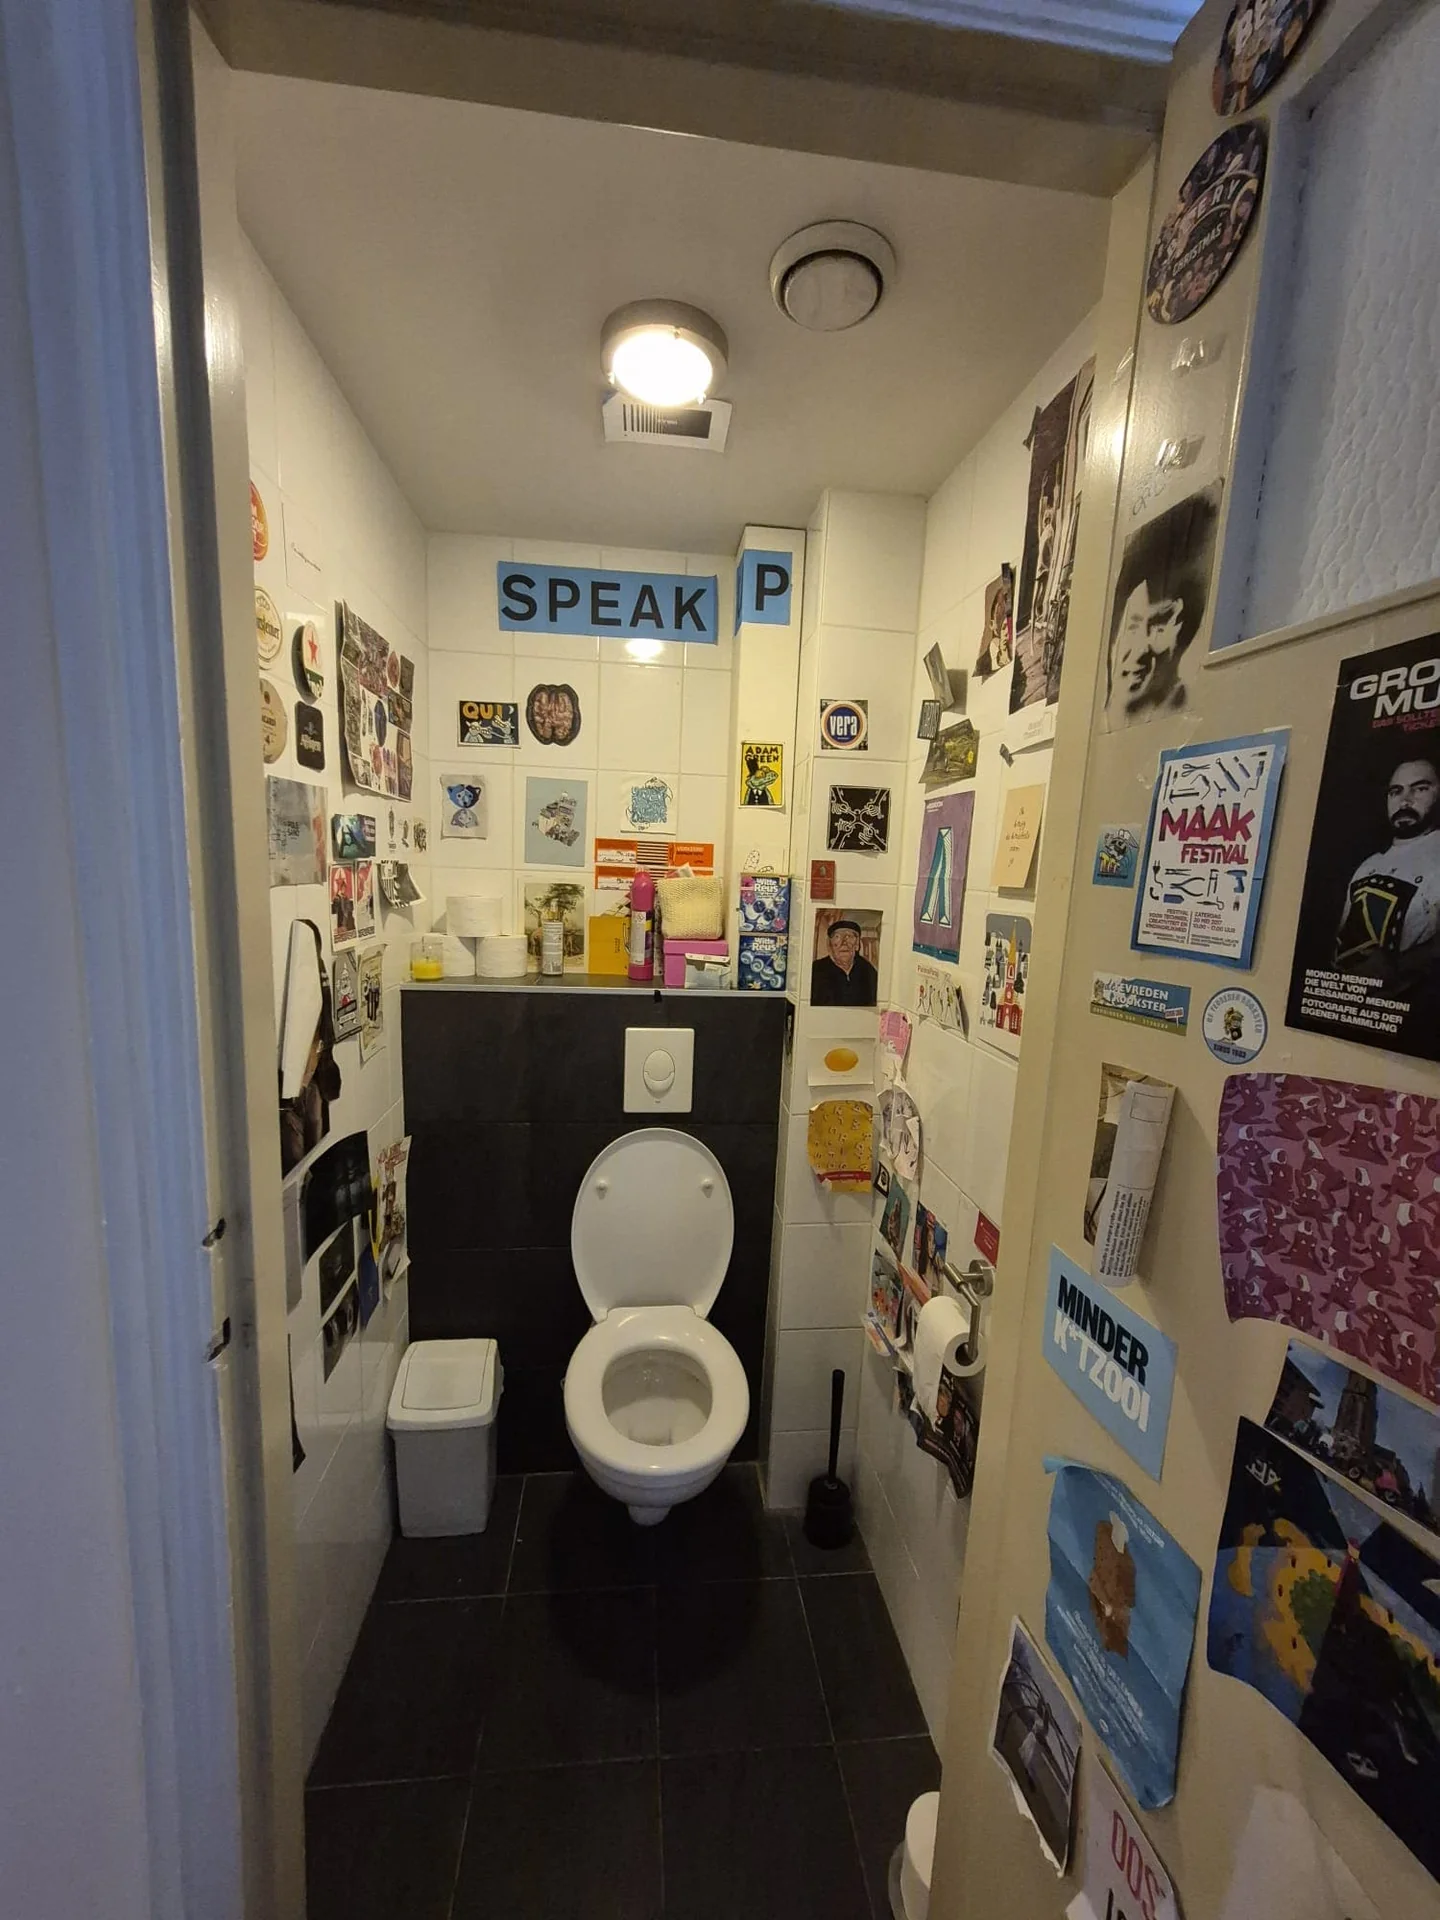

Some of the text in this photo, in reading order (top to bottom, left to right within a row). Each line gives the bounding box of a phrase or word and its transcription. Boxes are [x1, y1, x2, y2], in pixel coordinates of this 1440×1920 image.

[501, 574, 707, 631] SPEAK
[830, 716, 857, 736] vera
[746, 746, 779, 754] ADAM
[1158, 803, 1256, 842] MAAK
[1181, 843, 1249, 865] FESTIVAL
[754, 883, 778, 893] Reus
[1194, 911, 1222, 919] ZATERDAG
[752, 942, 776, 951] Reus
[1304, 977, 1367, 995] DIE WELT VON
[1305, 969, 1383, 988] MONDO MENDINI
[1303, 986, 1411, 1012] ALESSANDRO MENDINI
[1300, 1006, 1398, 1033] EIGENEN SAMMLUNG
[1301, 998, 1403, 1025] FOTOGRAFIE AUS DER
[1058, 1274, 1149, 1387] MINDER
